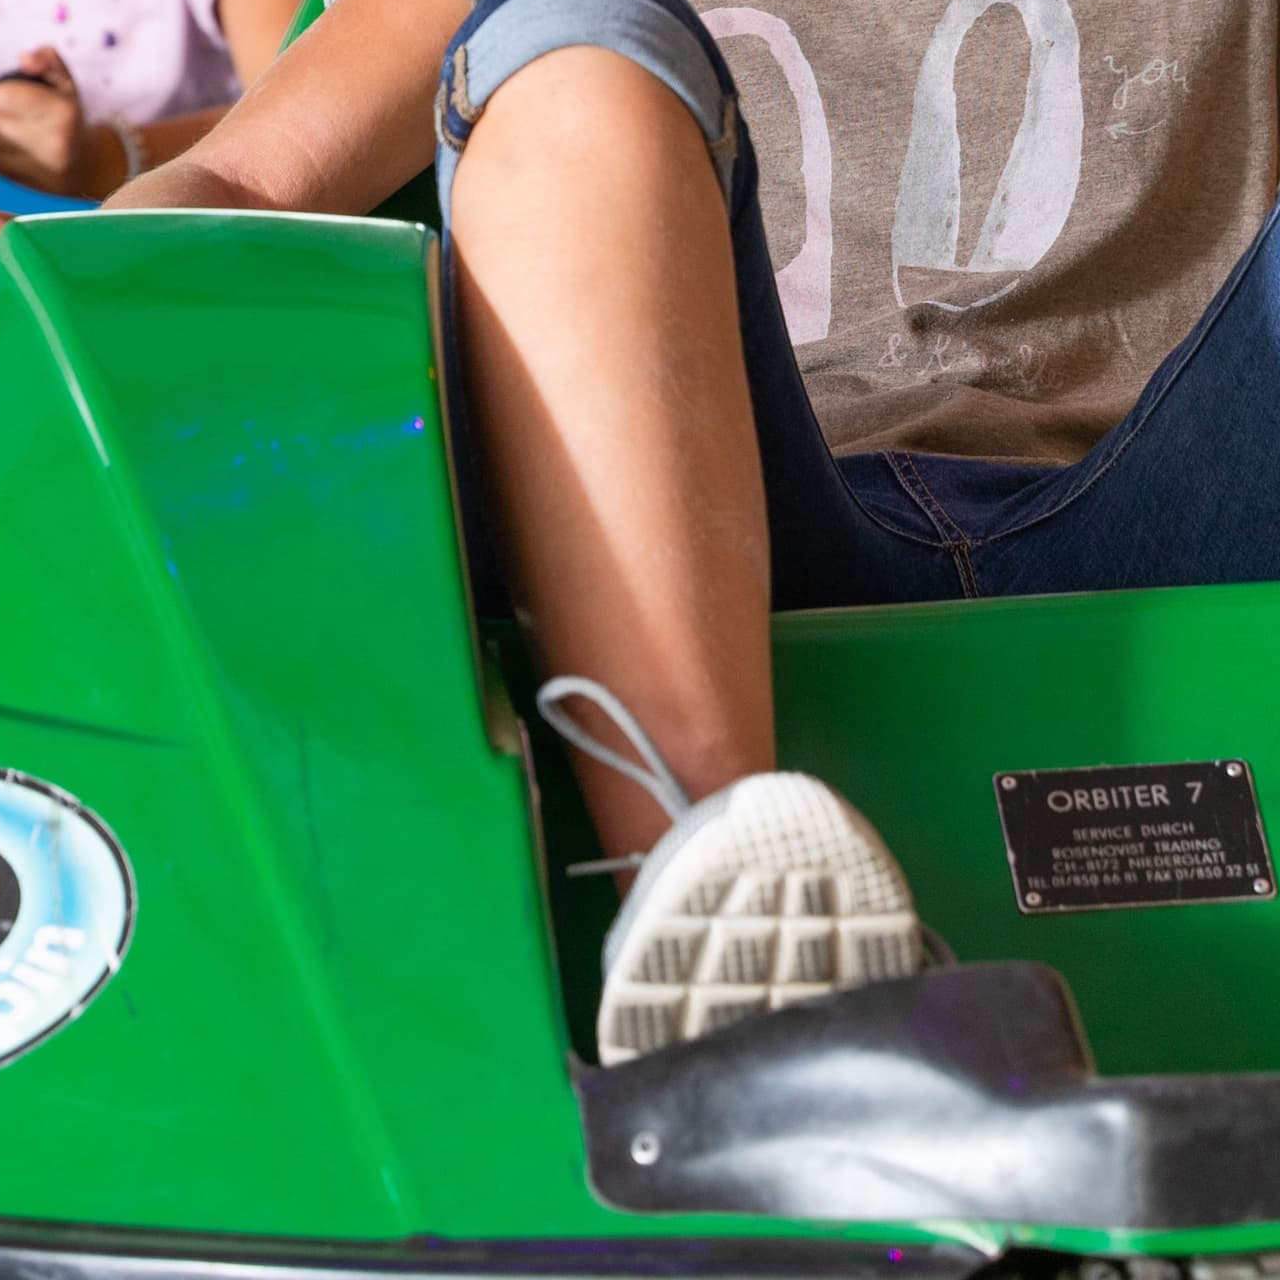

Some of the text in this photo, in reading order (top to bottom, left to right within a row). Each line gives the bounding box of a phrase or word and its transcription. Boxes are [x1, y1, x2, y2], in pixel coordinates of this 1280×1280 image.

[1046, 781, 1204, 814] ORBITER 7
[1072, 821, 1195, 841] SERVICE DURCH
[1154, 837, 1222, 854] TRADING
[1128, 850, 1227, 870] NIEDERGLATT
[1146, 869, 1172, 884] FAX
